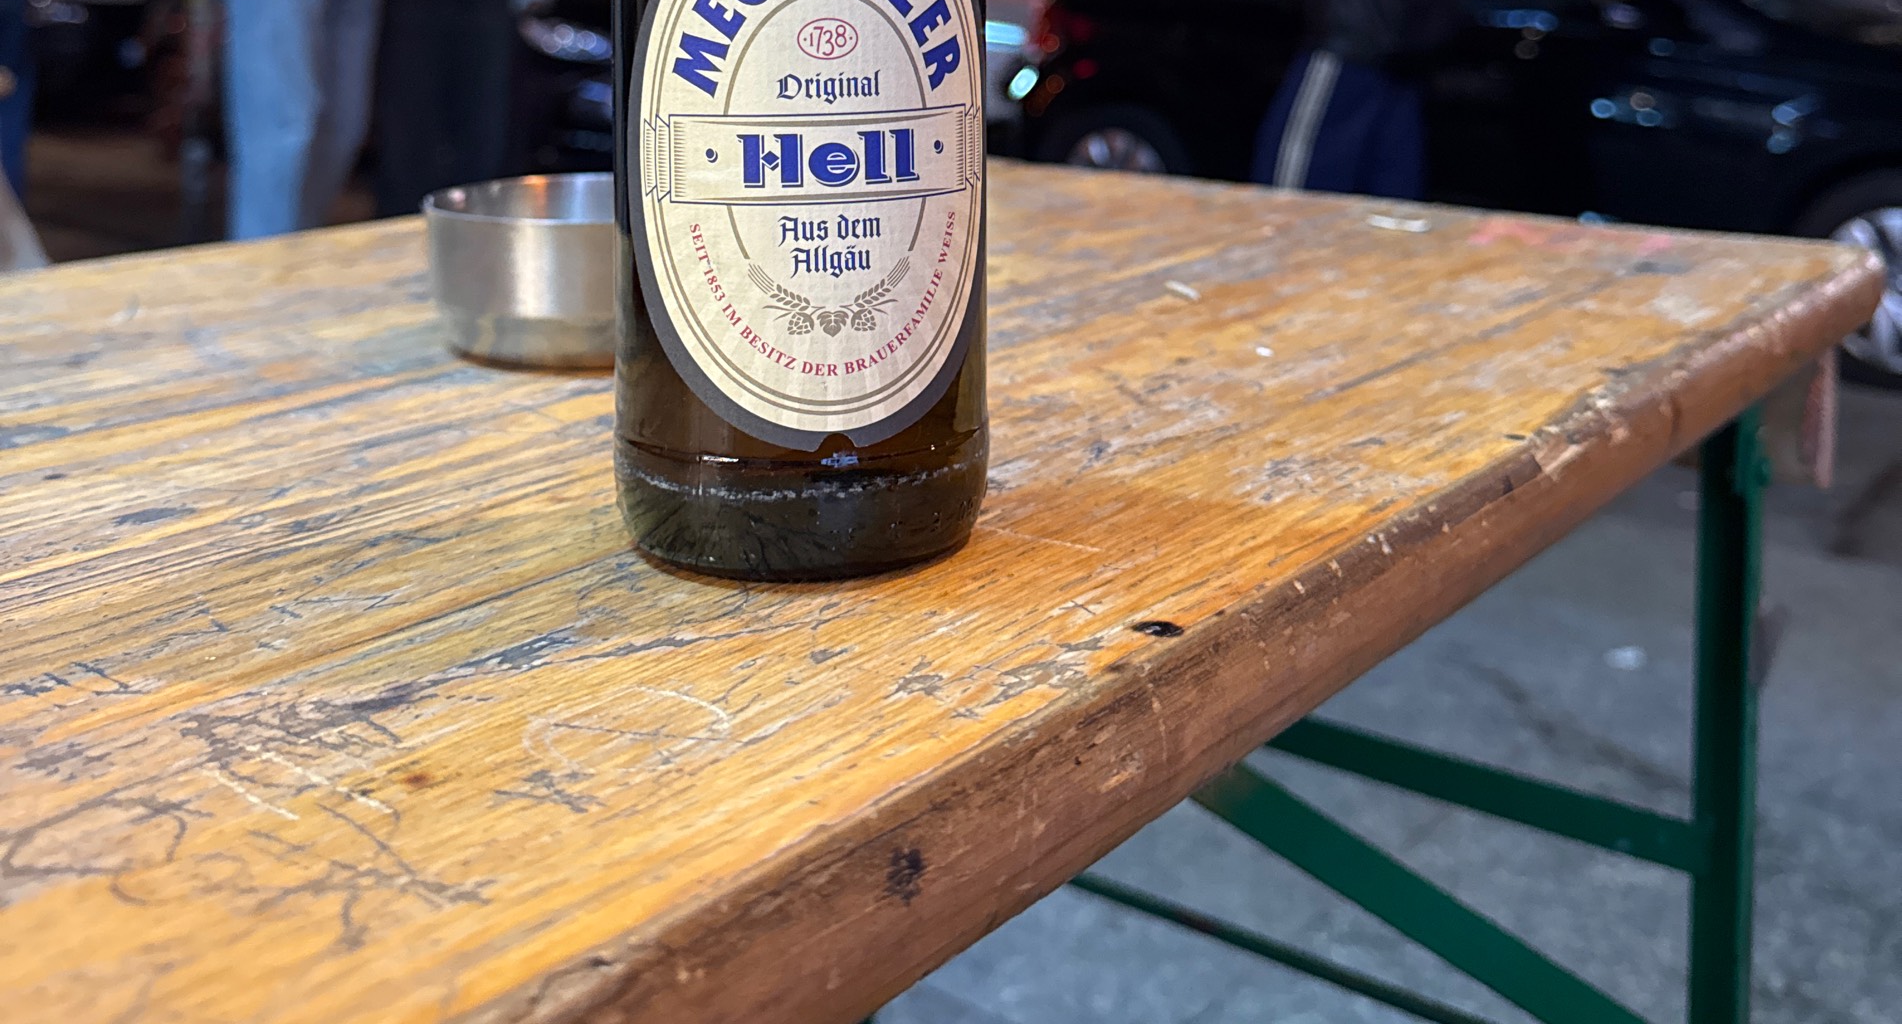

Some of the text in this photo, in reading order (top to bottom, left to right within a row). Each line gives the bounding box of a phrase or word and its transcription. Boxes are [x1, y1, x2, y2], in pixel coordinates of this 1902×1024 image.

[776, 69, 881, 104] Original
[736, 128, 920, 188] Hell
[778, 214, 882, 247] Aus dem
[790, 245, 872, 278] Allgäu
[689, 210, 957, 377] SEIT 1853 IM BESITZ DER BRAUERFAMILIE WEISS
